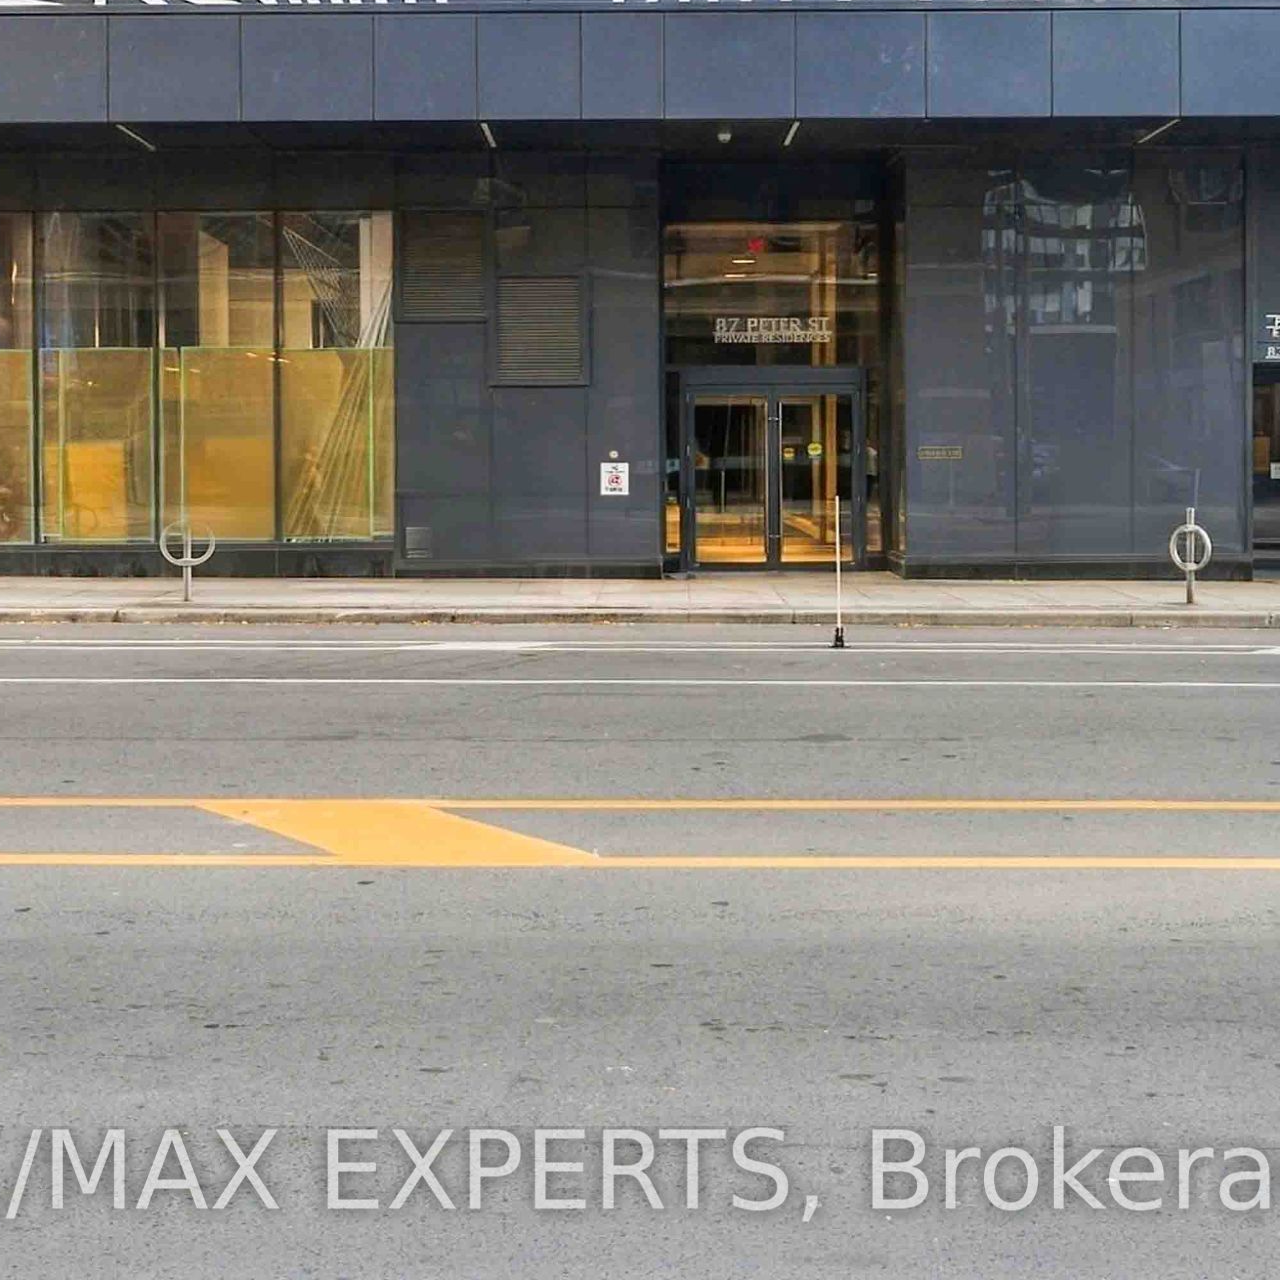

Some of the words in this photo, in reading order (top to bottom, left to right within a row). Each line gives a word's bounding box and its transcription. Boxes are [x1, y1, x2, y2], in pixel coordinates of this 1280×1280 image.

[747, 317, 801, 332] PETER
[808, 316, 830, 332] ST
[713, 331, 759, 343] PRIVATE
